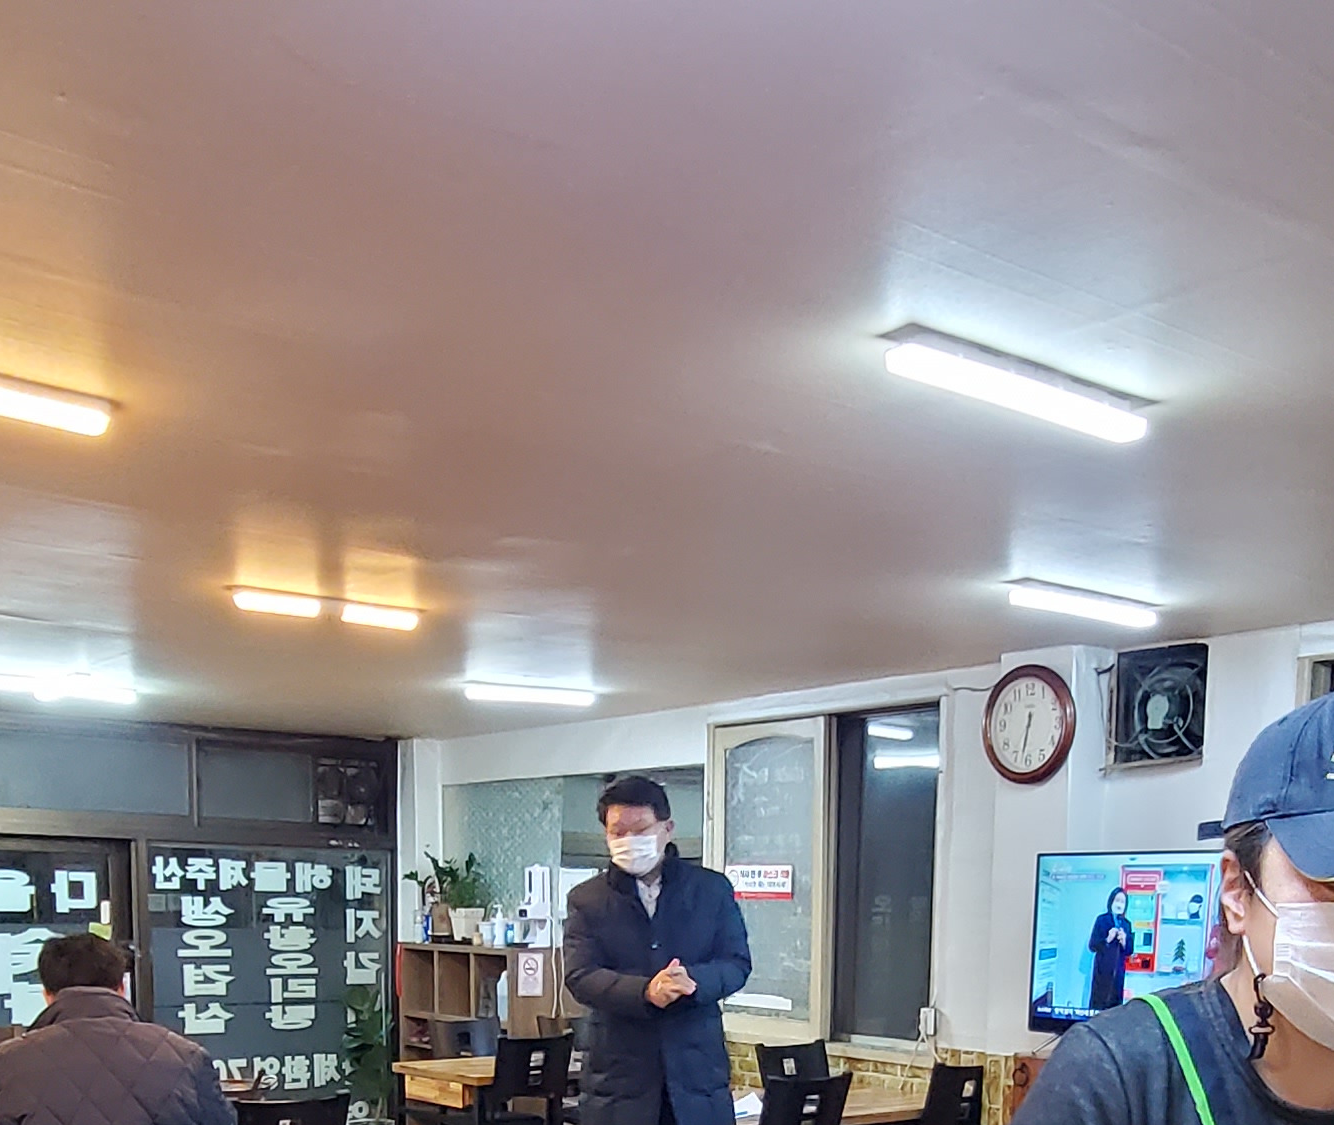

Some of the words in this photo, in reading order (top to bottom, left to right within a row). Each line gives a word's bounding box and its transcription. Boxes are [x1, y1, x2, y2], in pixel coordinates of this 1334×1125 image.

[1013, 689, 1022, 701] 11
[1024, 682, 1036, 697] 12
[1003, 702, 1013, 715] 10
[999, 720, 1006, 732] 9
[1054, 717, 1061, 730] 3
[1002, 737, 1010, 750] 8
[1024, 753, 1032, 767] 6
[1038, 749, 1046, 762] 5
